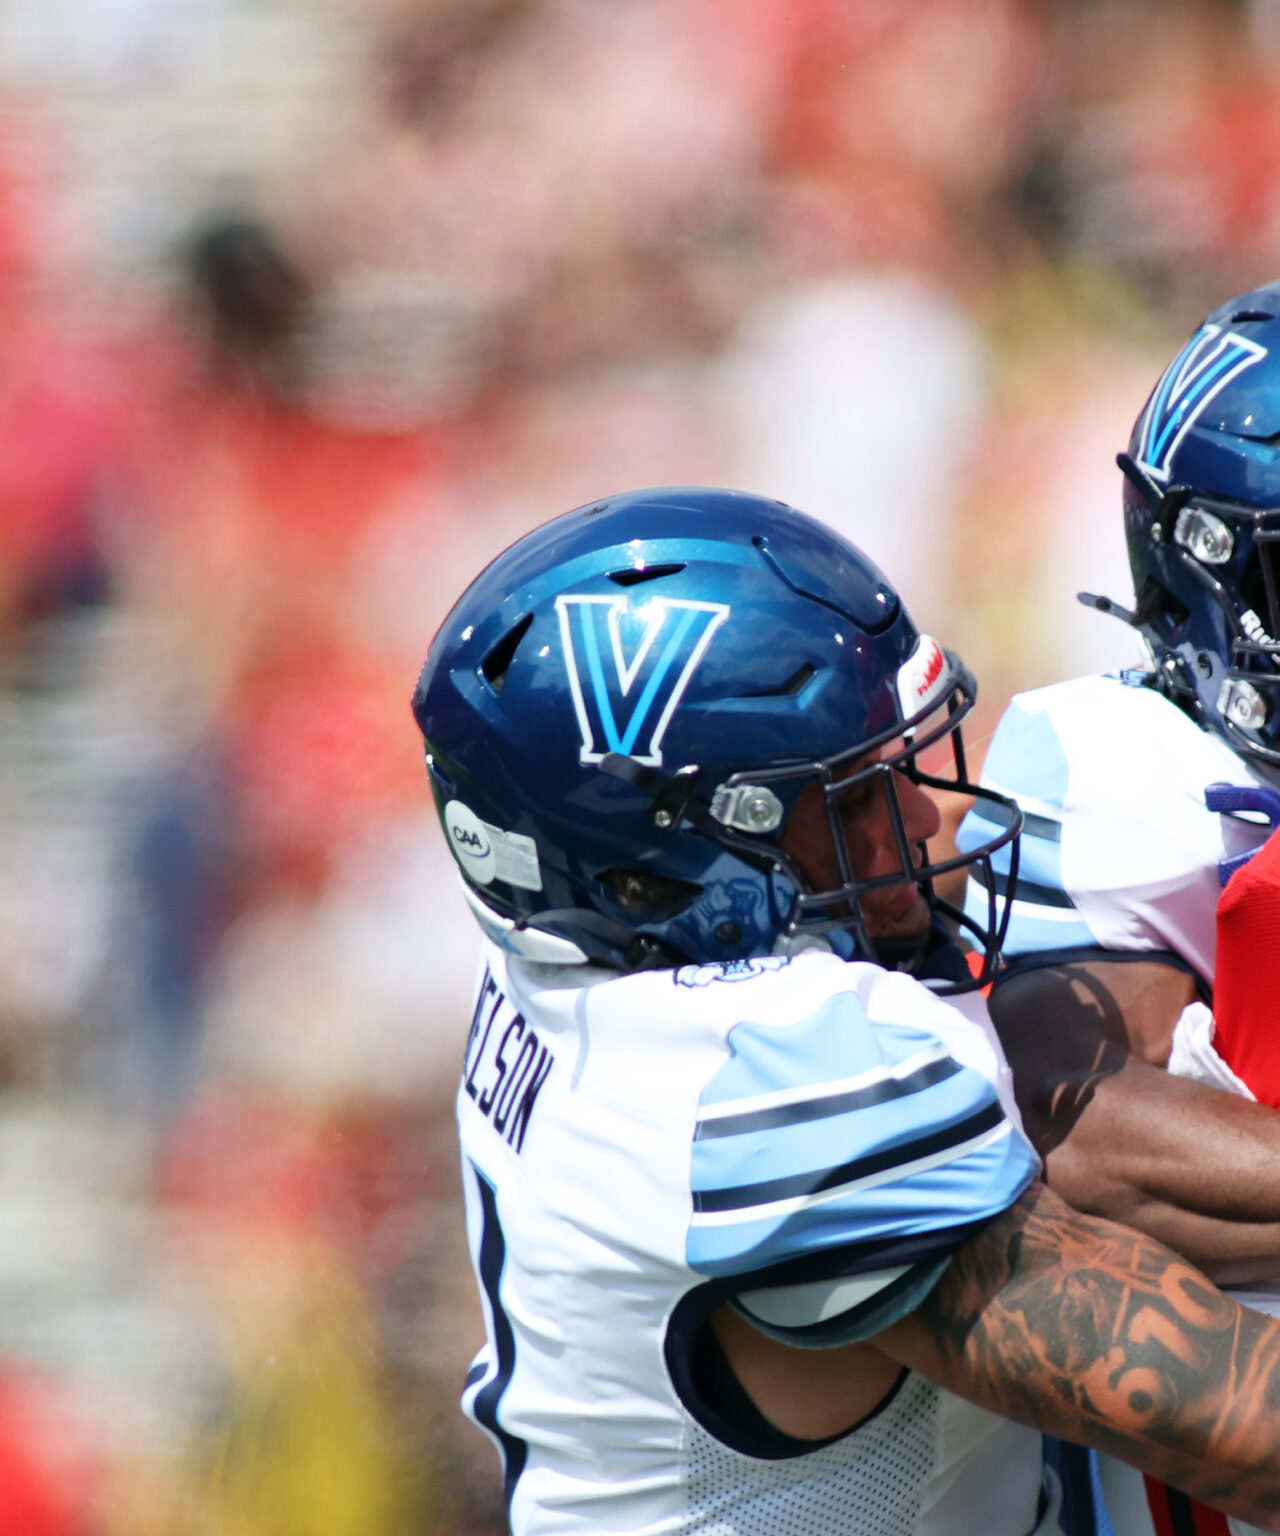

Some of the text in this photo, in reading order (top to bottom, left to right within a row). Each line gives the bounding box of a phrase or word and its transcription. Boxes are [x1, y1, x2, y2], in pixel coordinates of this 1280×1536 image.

[1136, 323, 1268, 484] V
[554, 594, 731, 768] V
[452, 825, 483, 850] CAA
[465, 962, 554, 1155] ELSON
